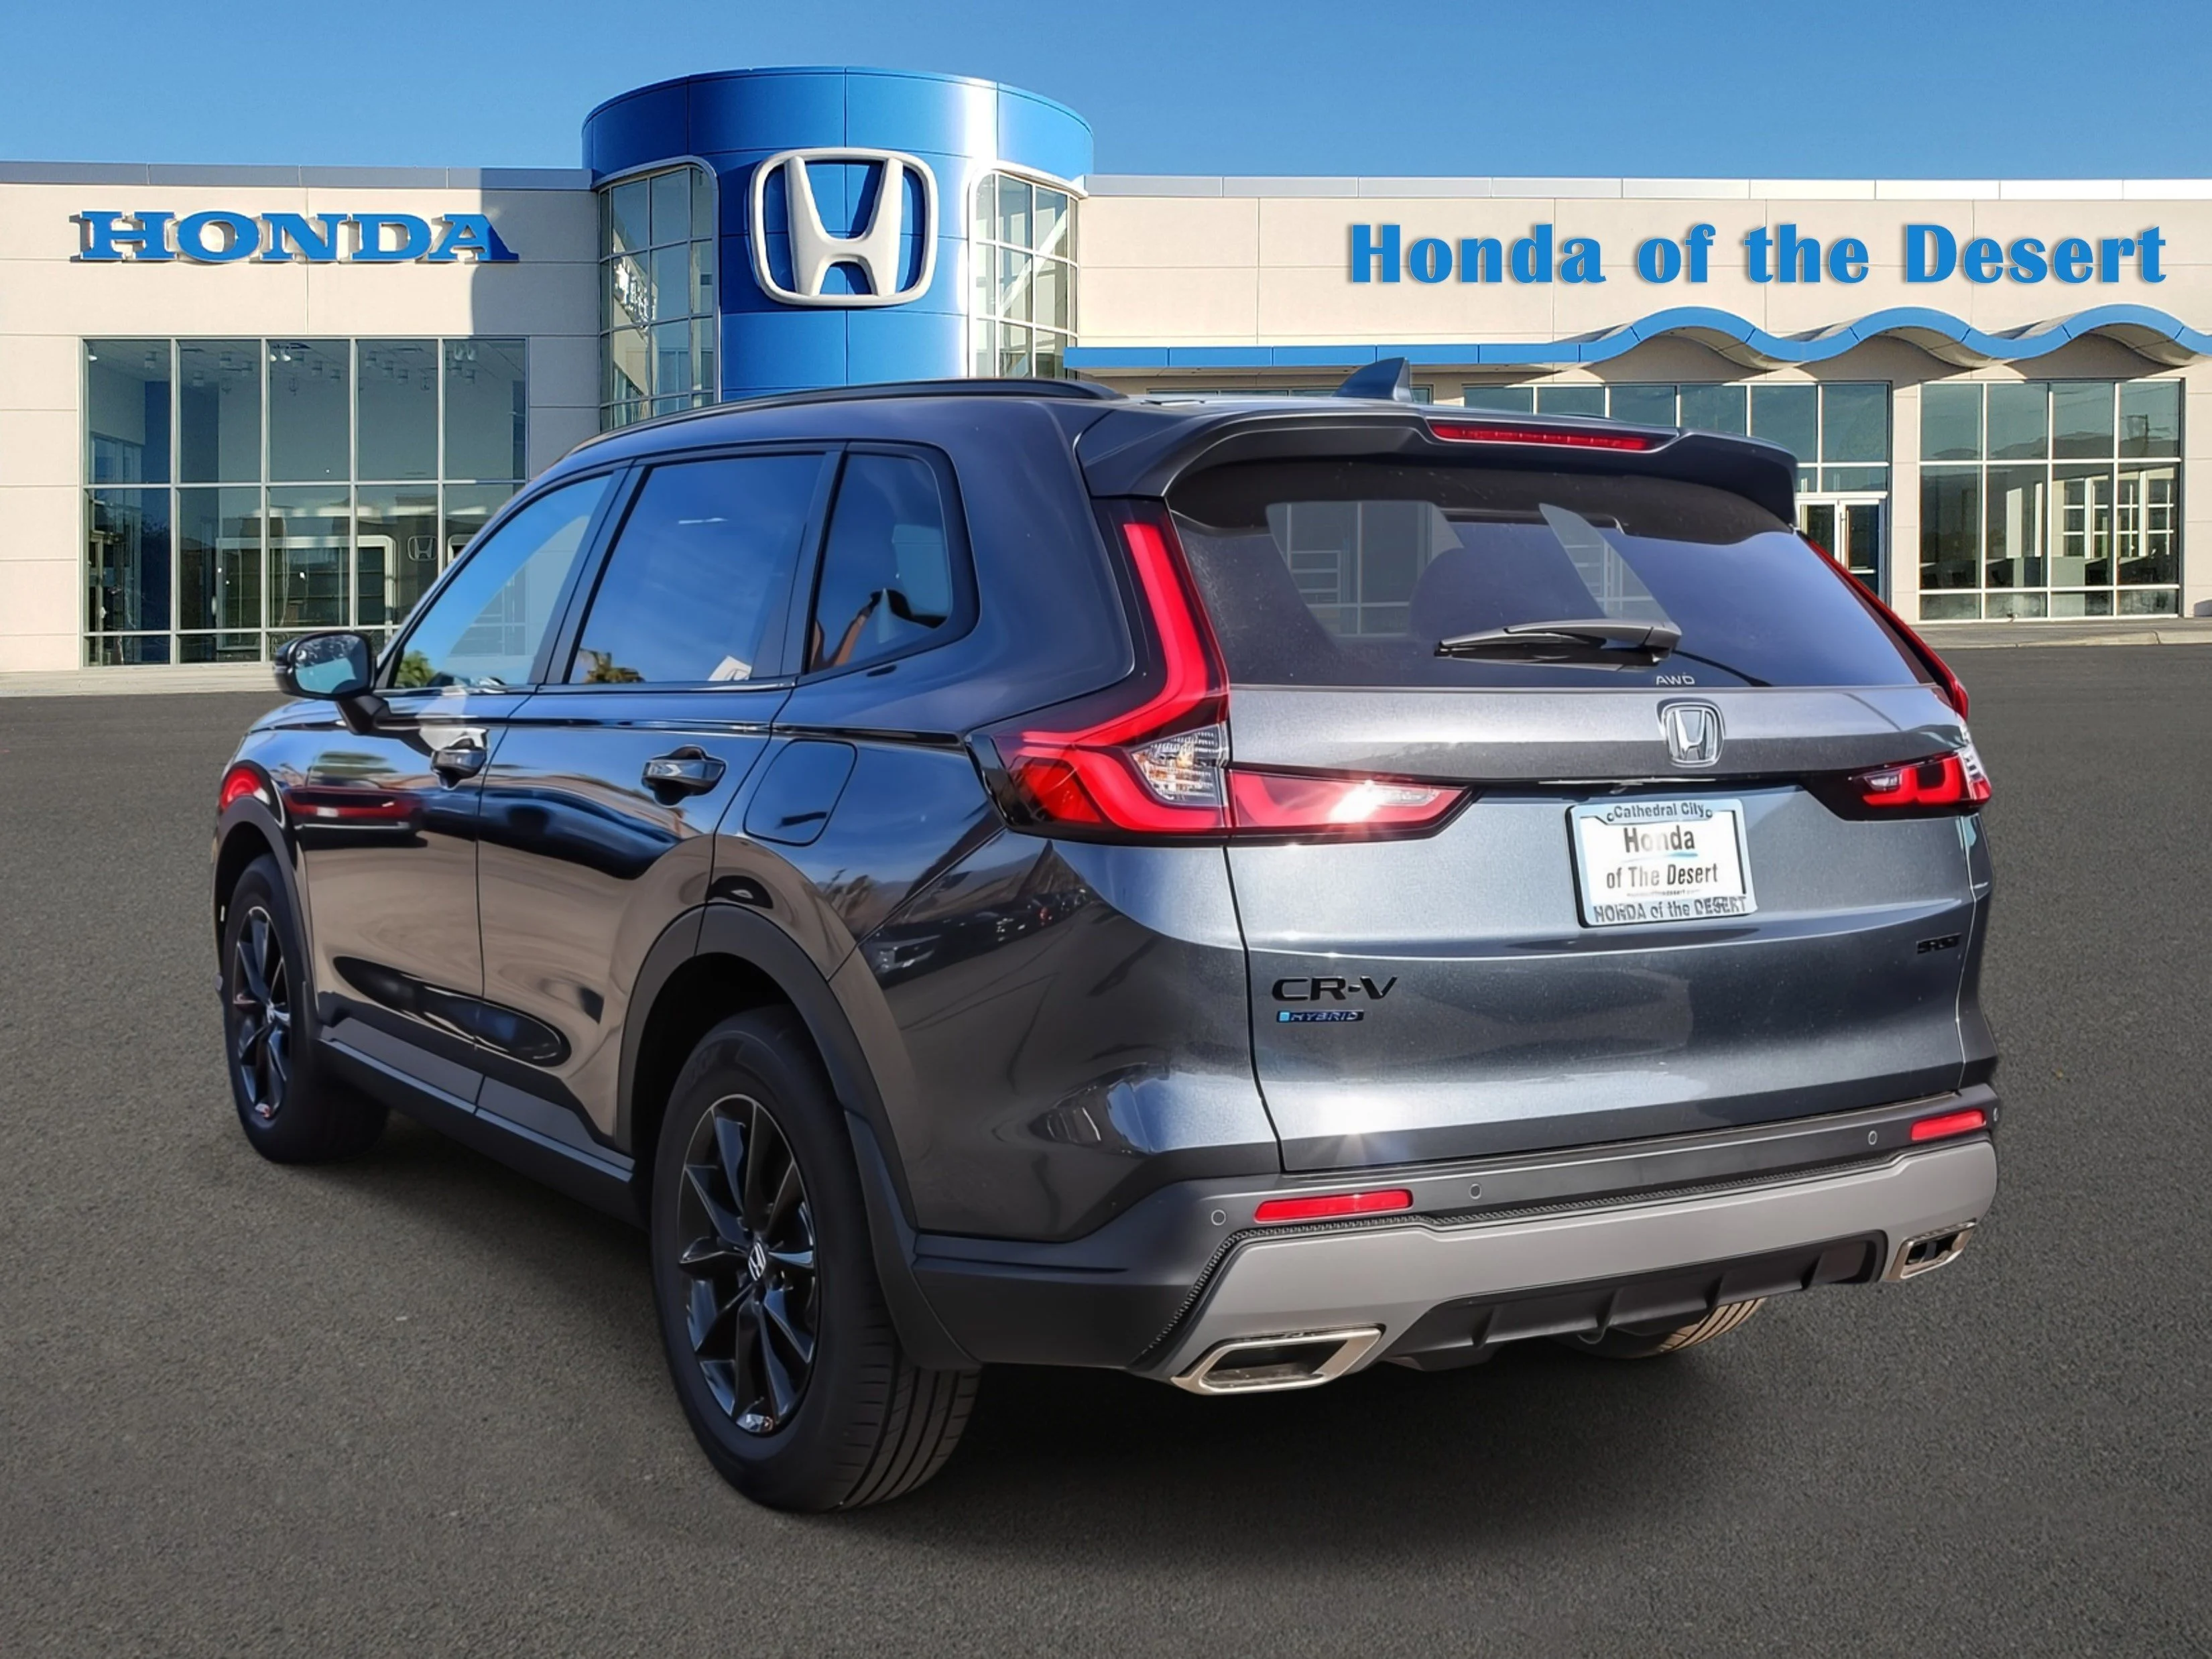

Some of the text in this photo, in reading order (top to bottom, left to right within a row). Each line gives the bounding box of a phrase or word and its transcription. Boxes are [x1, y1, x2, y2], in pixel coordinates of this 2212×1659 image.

[80, 210, 519, 263] HONDA
[1352, 224, 2166, 284] Honda of the Desert
[1656, 674, 1695, 686] AWD
[1613, 802, 1705, 818] Cathedral City
[1623, 824, 1696, 853] Honda
[1606, 863, 1719, 889] of The Desert
[1593, 896, 1747, 923] HONDA of the DESERT
[1272, 975, 1398, 1001] CR-V
[1290, 1011, 1359, 1022] HYBRID
